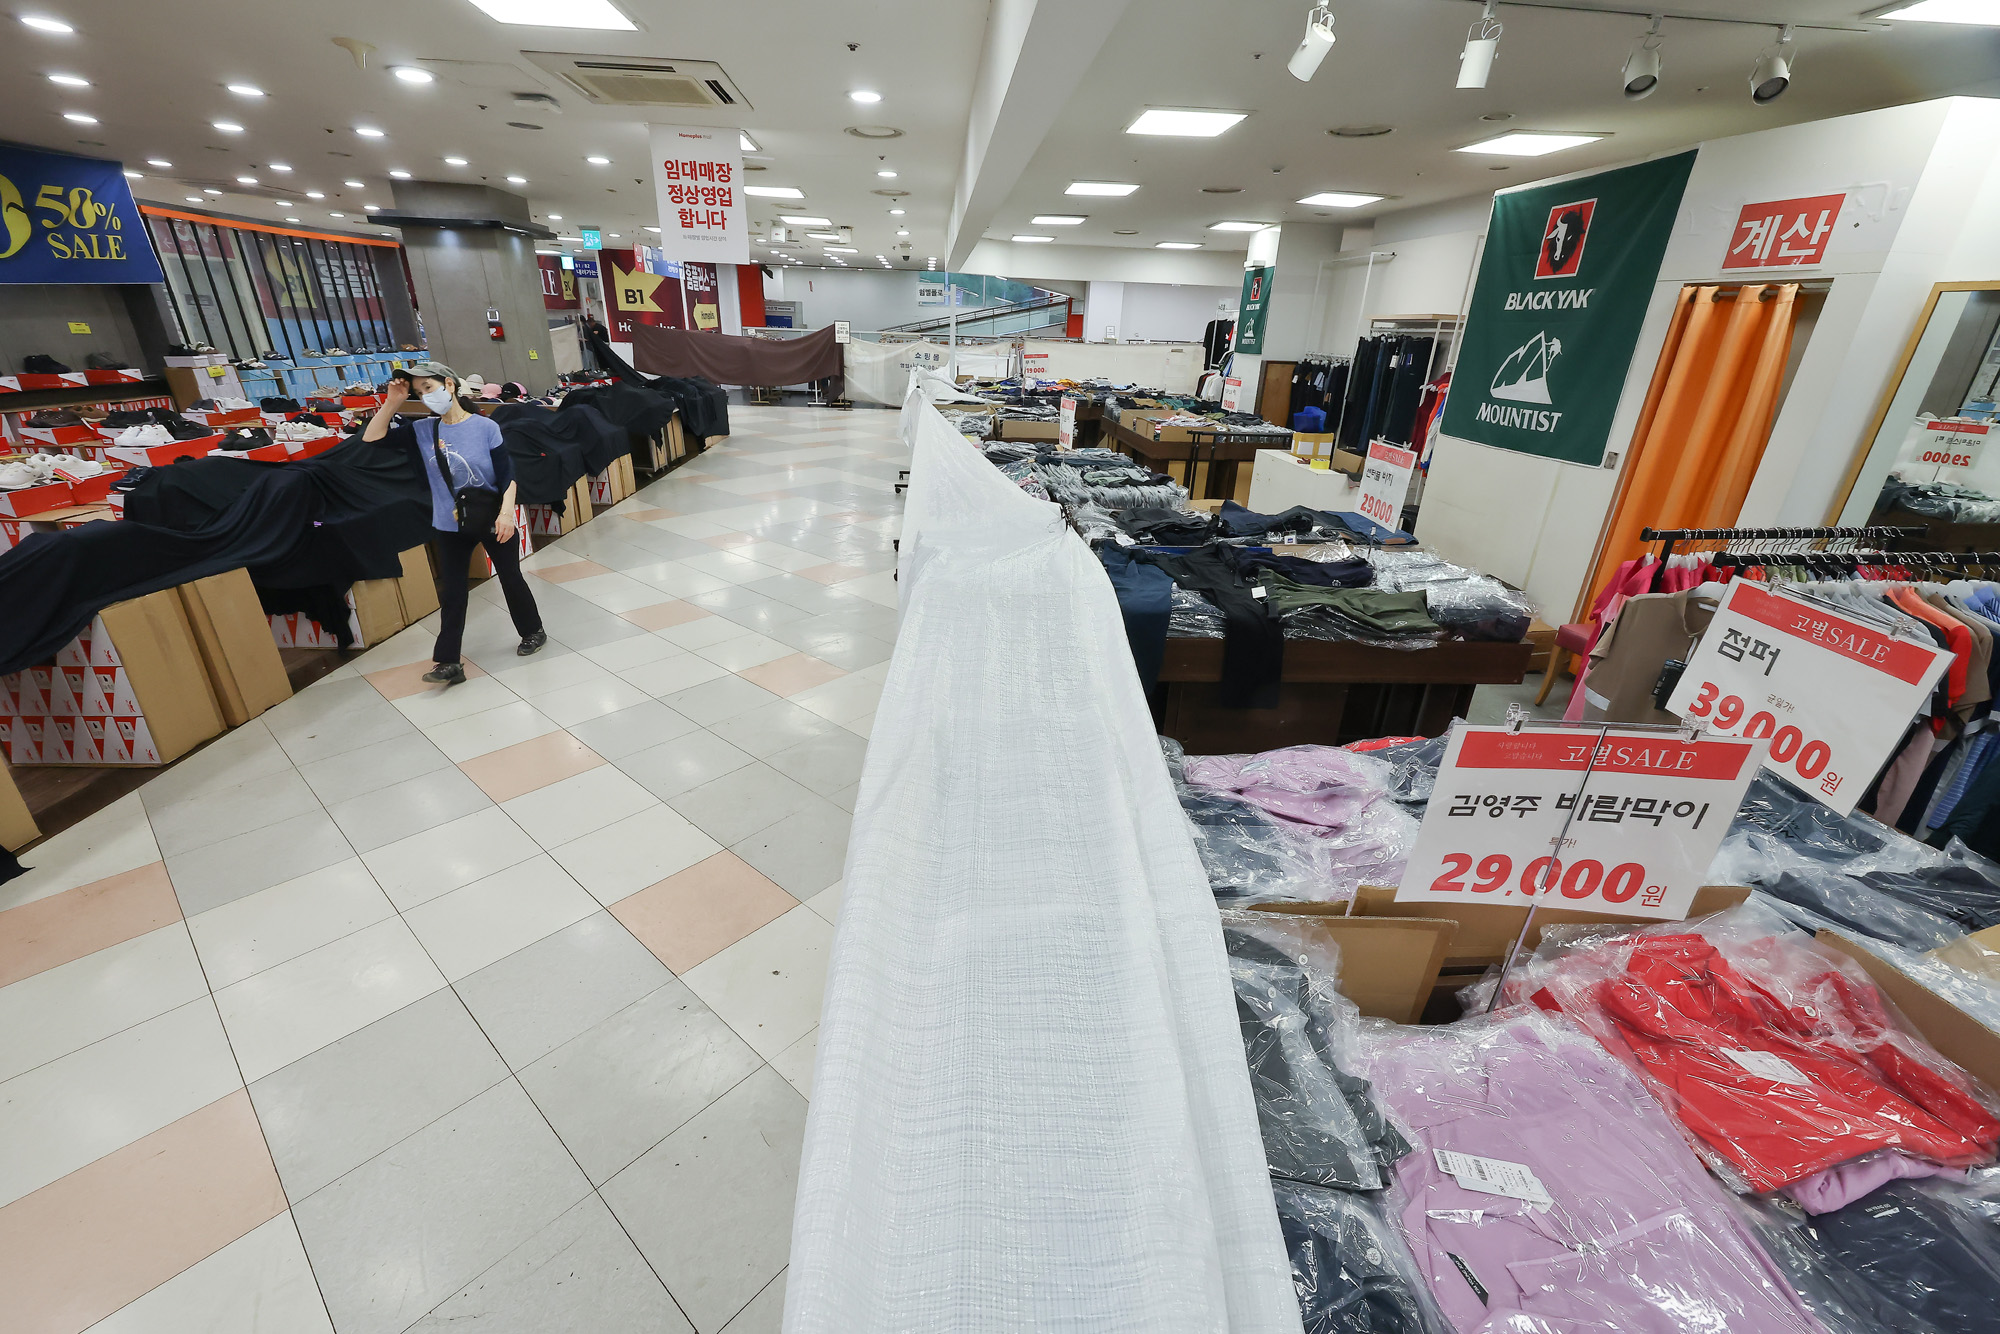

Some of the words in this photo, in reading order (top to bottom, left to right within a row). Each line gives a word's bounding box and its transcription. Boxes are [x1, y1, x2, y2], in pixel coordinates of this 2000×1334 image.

[664, 160, 733, 183] 임대매장
[668, 184, 733, 207] 정상영업
[678, 208, 727, 230] 합니다
[47, 233, 126, 260] SALE
[1732, 209, 1831, 260] 계산
[625, 289, 645, 305] B1
[1475, 402, 1562, 432] MOUNTIST
[1717, 627, 1781, 677] 점퍼
[1790, 614, 1891, 664] 고별SALE
[1688, 681, 1844, 797] 39000원
[1559, 743, 1698, 771] 고별SALE
[1448, 794, 1542, 819] 김영주
[1555, 792, 1709, 830] 바람막이
[1430, 853, 1666, 908] 29,000원
